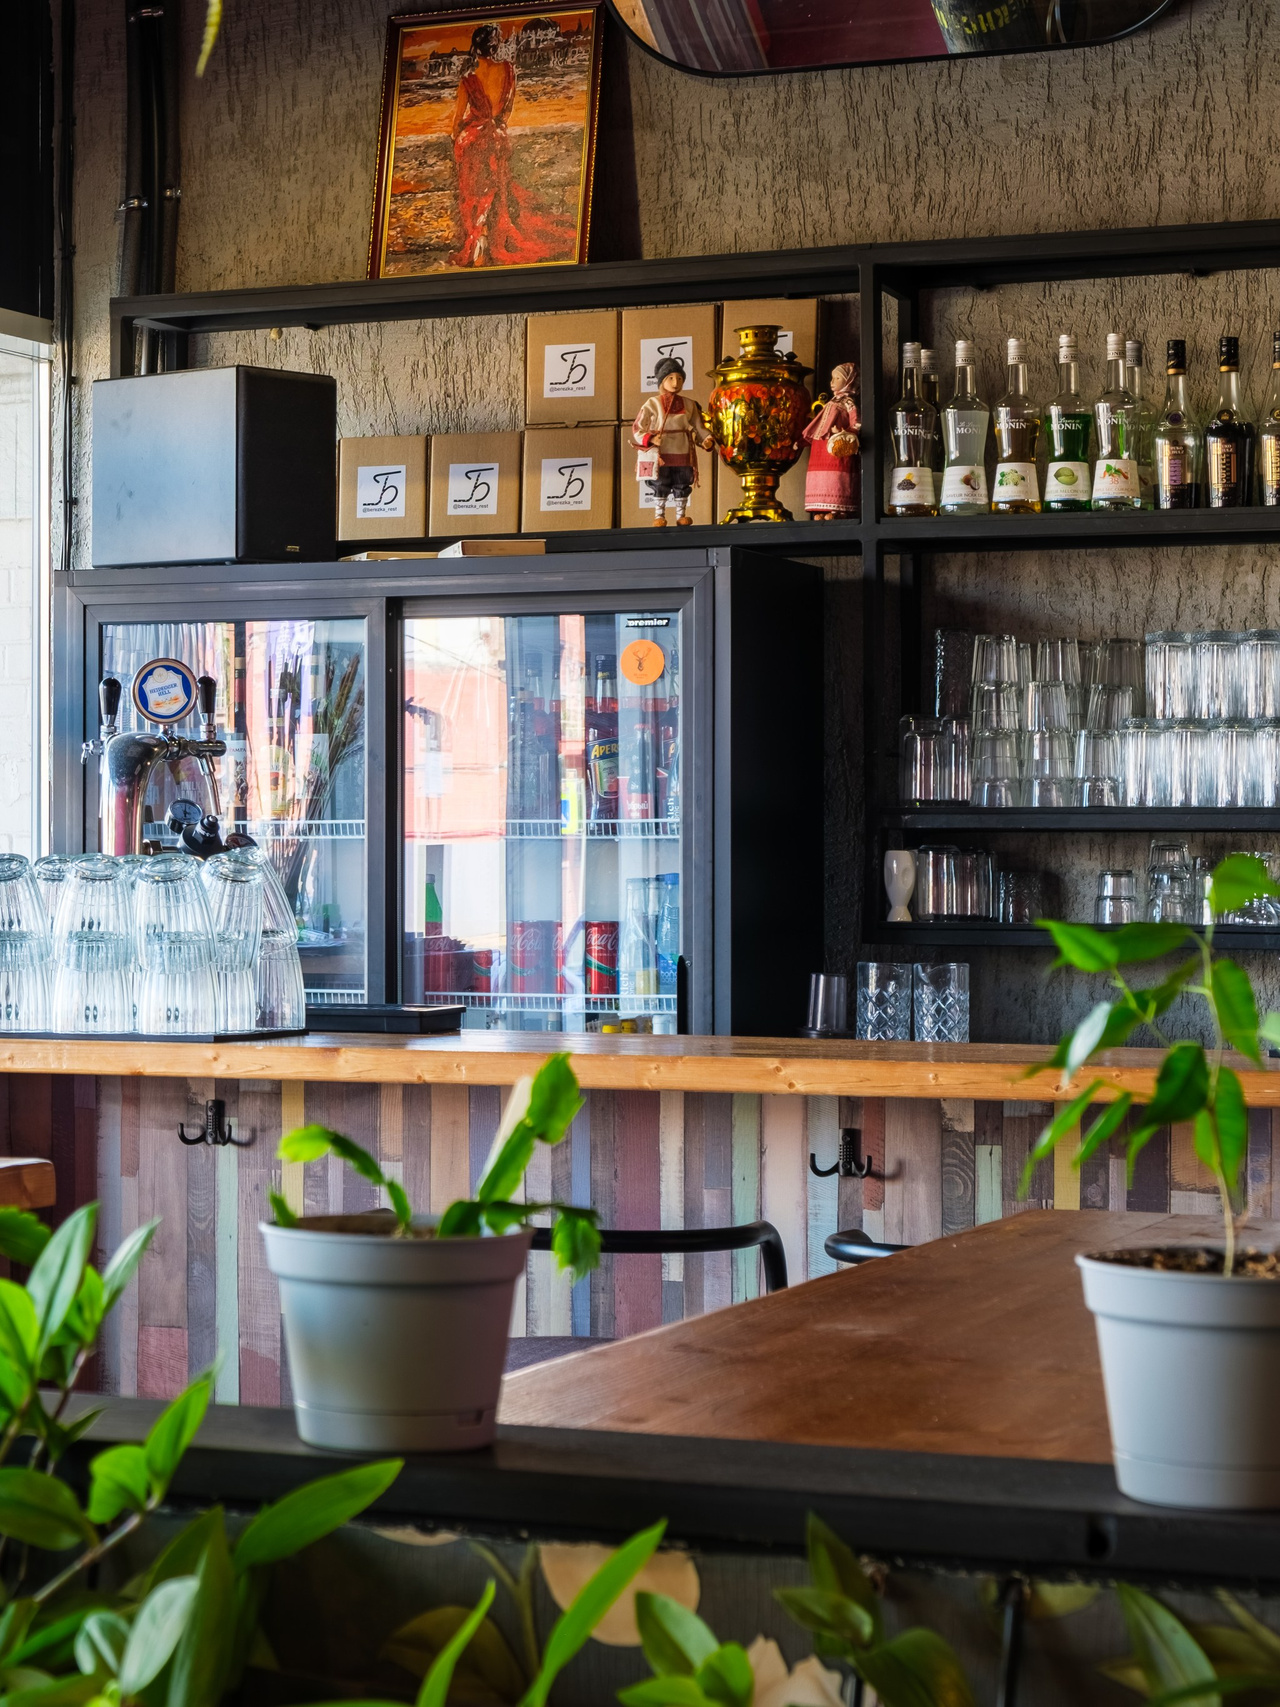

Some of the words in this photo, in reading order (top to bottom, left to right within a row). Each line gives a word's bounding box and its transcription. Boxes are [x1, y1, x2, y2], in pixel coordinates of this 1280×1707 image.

[549, 385, 586, 393] @berezka_rest
[1050, 423, 1082, 431] MONIN
[894, 428, 925, 436] MONIN
[1170, 459, 1182, 485] CASSIS
[362, 506, 398, 514] @berezka_rest
[627, 618, 669, 627] premier
[591, 743, 619, 759] APER
